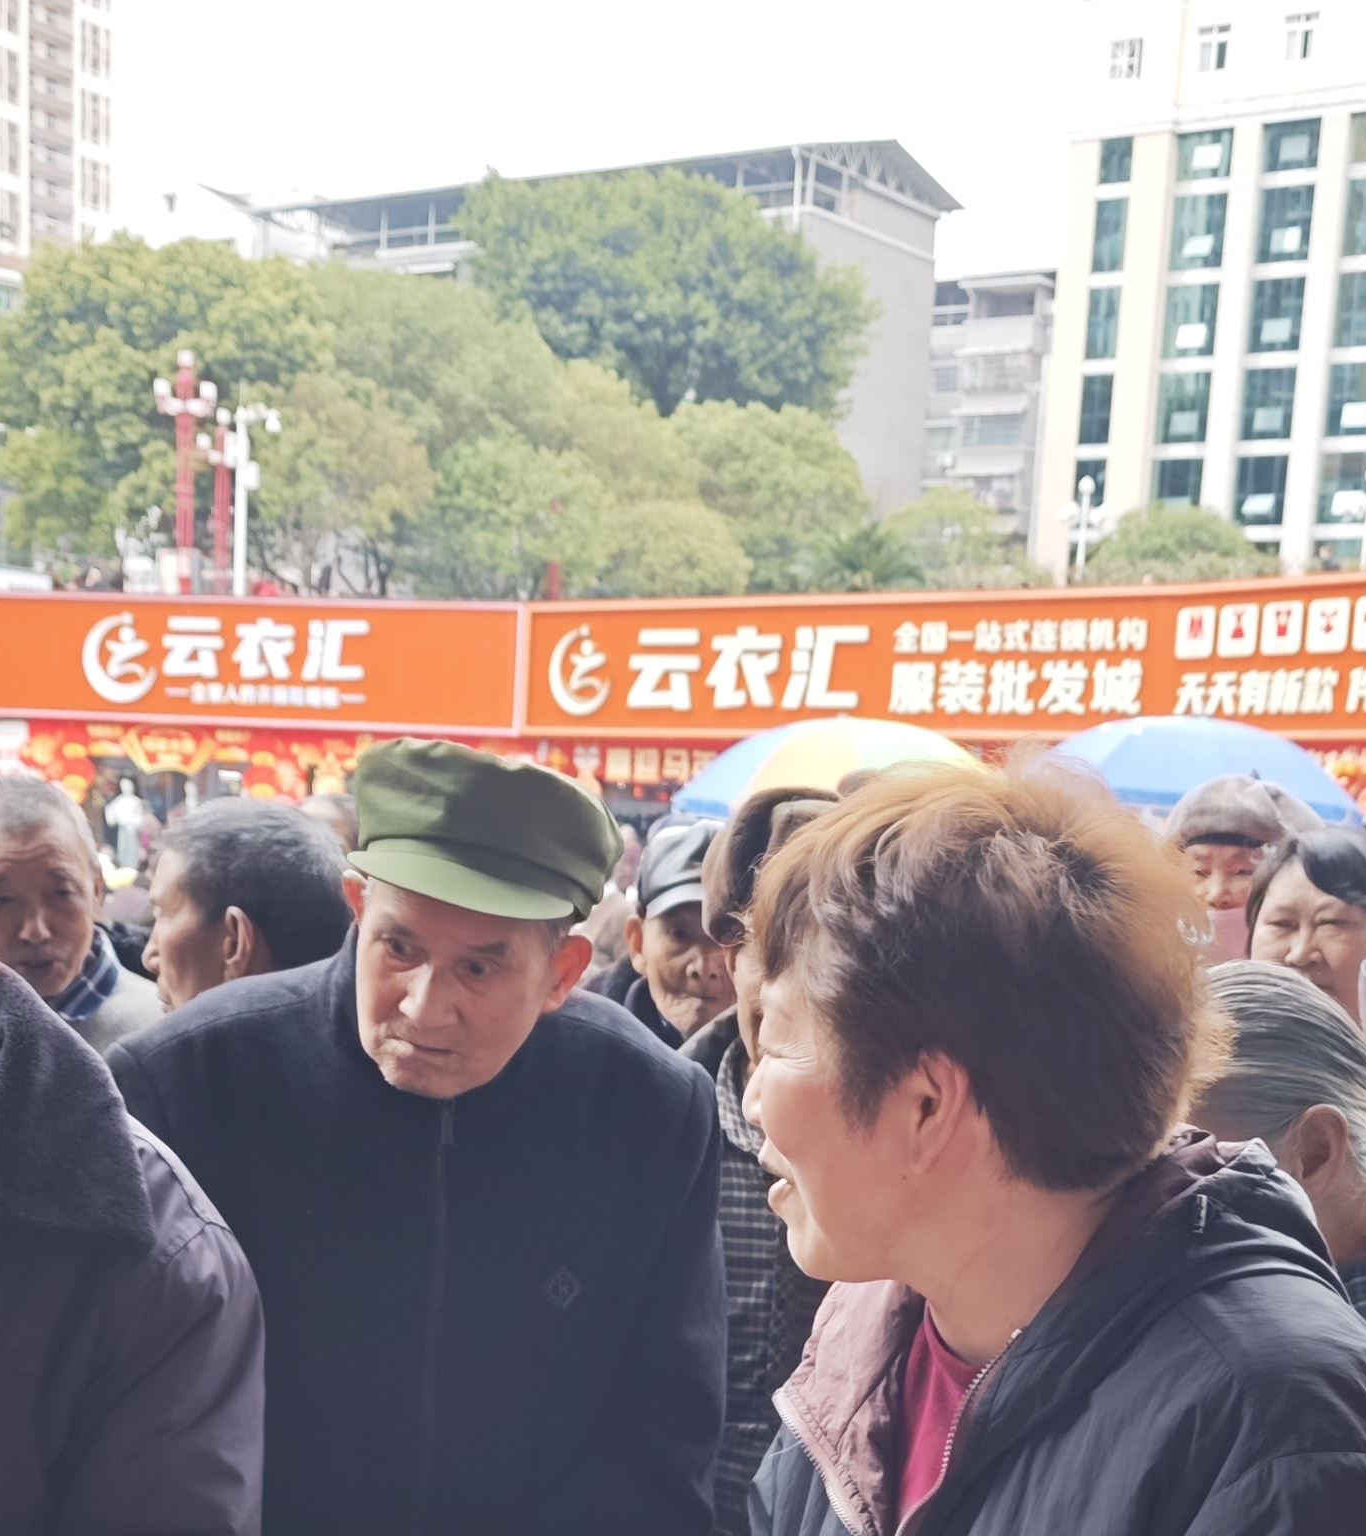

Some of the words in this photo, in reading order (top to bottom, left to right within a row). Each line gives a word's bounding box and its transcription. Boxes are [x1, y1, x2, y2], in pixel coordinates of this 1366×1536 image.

[162, 615, 371, 680] 云衣汇
[893, 617, 1148, 654] 全国一站式连锁机构
[626, 625, 869, 710] 云衣汇
[888, 658, 1143, 715] 服装批发城
[1173, 667, 1339, 716] 天天有新款
